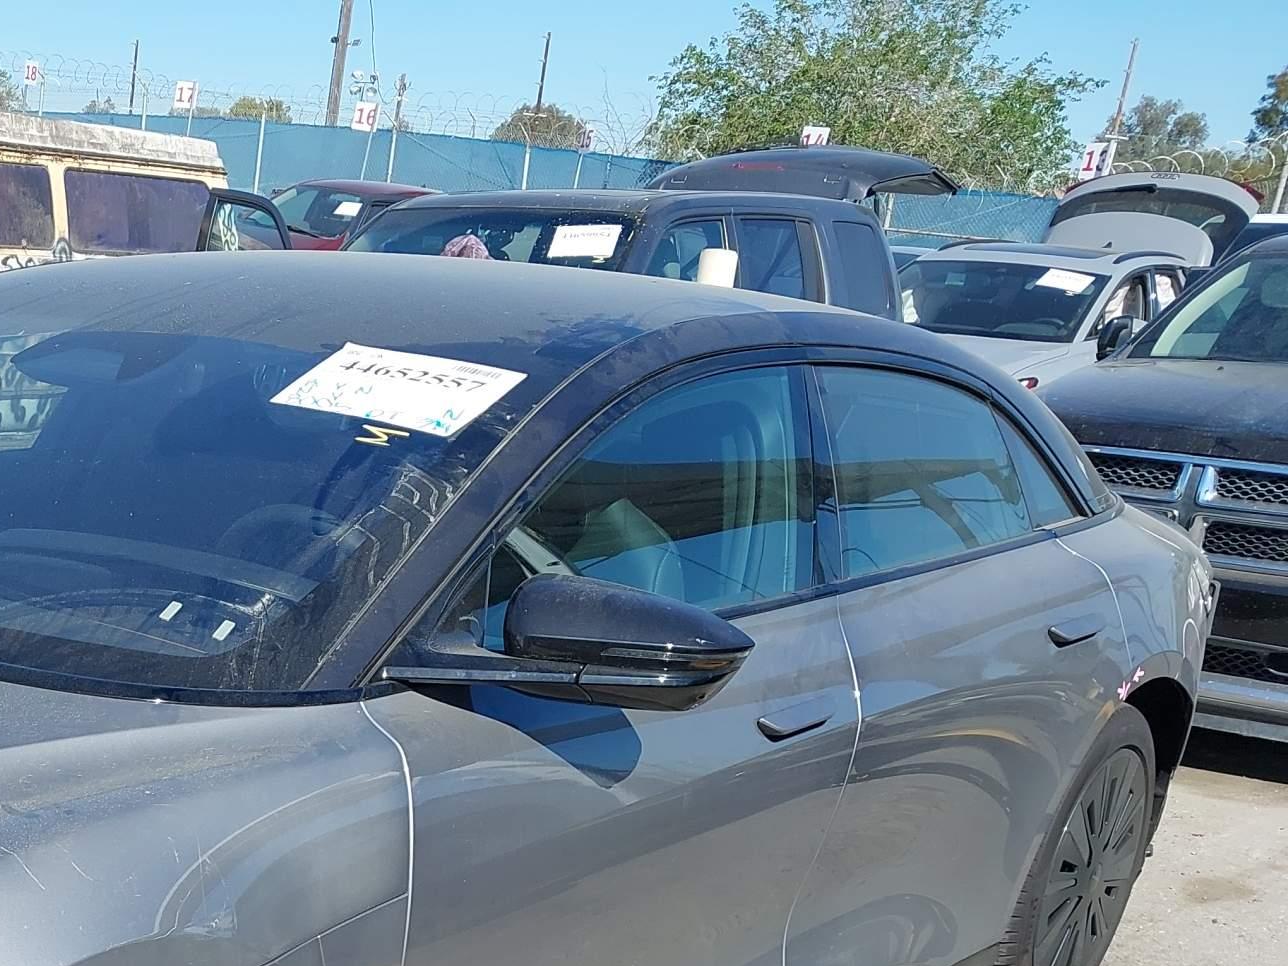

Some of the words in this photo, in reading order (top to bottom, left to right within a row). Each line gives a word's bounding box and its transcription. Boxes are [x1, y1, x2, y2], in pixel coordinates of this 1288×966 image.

[24, 64, 38, 81] 18
[176, 86, 194, 103] 17
[354, 107, 377, 127] 16
[579, 129, 594, 149] 15
[339, 359, 487, 393] 44652557
